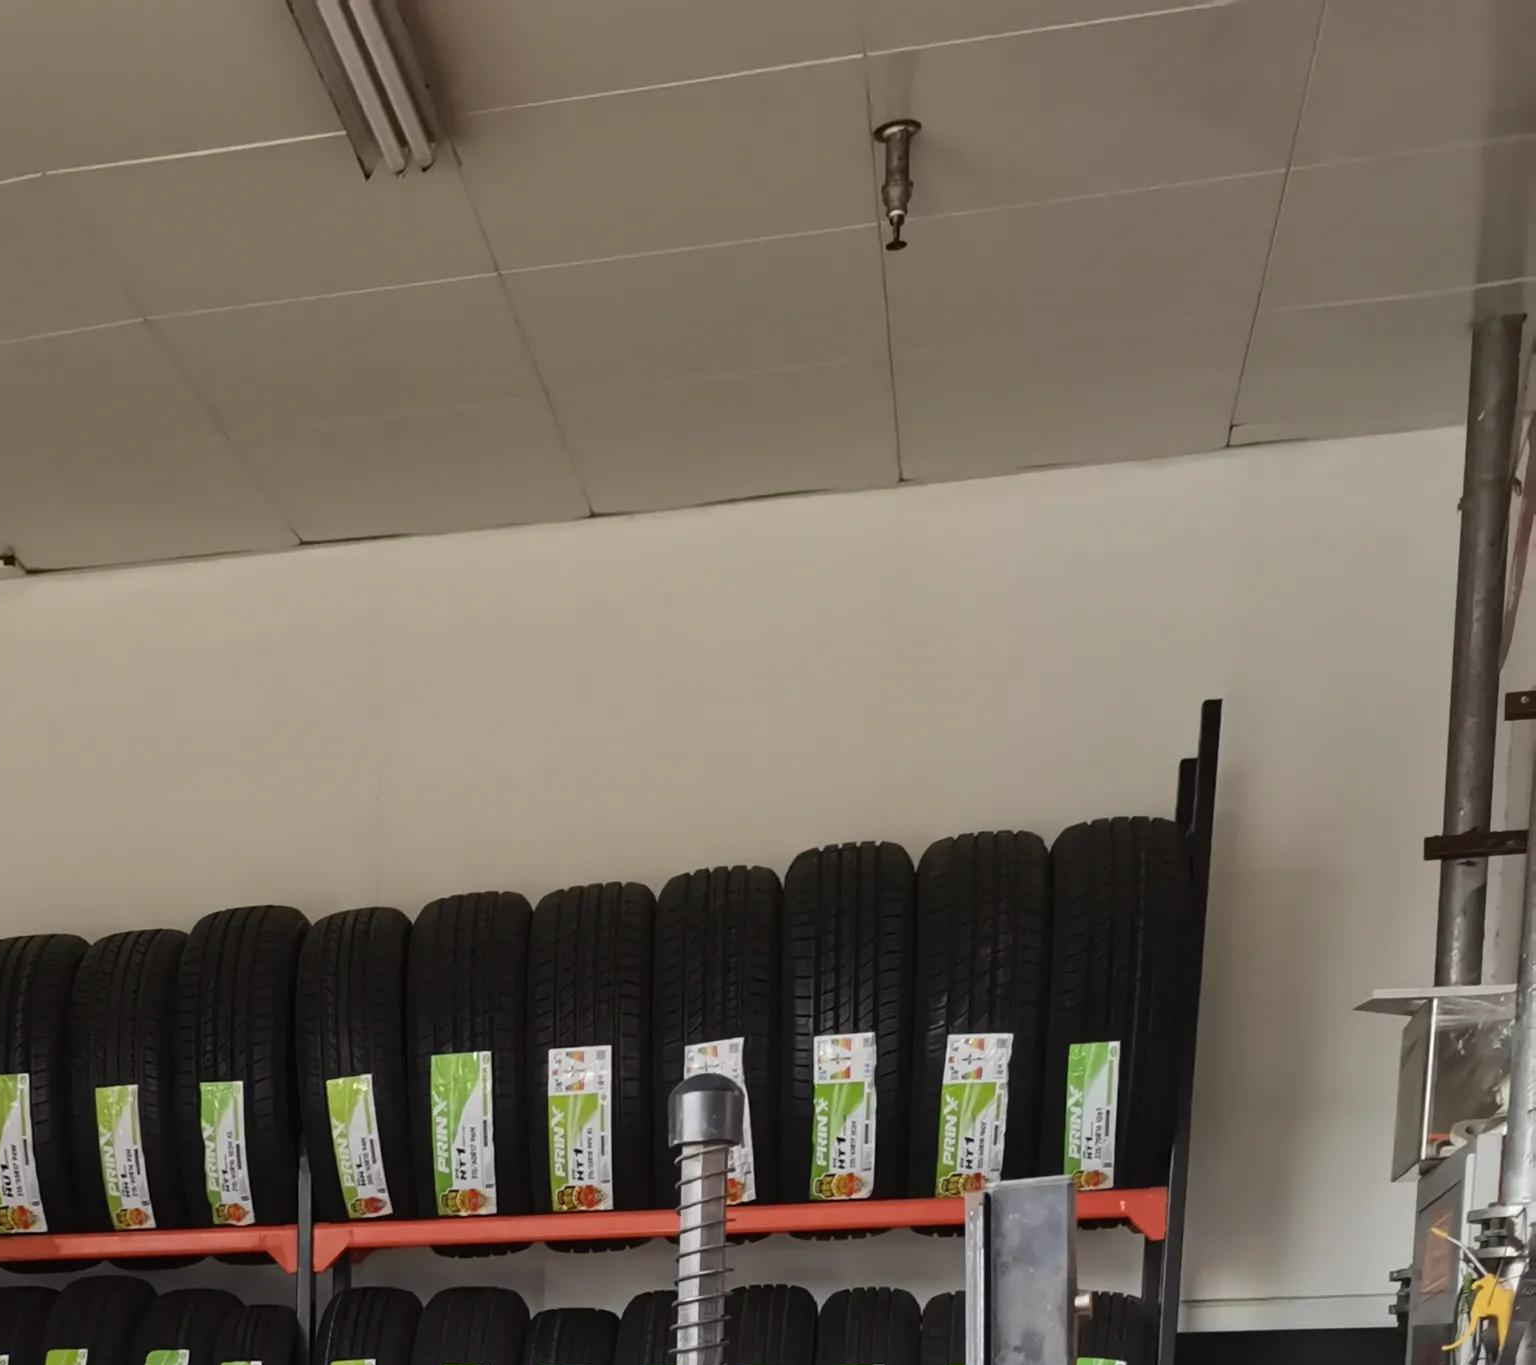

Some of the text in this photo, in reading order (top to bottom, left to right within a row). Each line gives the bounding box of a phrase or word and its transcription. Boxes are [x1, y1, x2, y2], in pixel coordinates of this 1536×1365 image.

[203, 1122, 220, 1192] PRINX
[332, 1120, 355, 1187] PRINX
[432, 1089, 450, 1173] PRINX
[552, 1107, 568, 1177] PRINX
[814, 1096, 831, 1166] PRINX
[942, 1091, 959, 1166] PRINX
[1068, 1087, 1085, 1160] PRINX
[99, 1128, 121, 1196] PRINX
